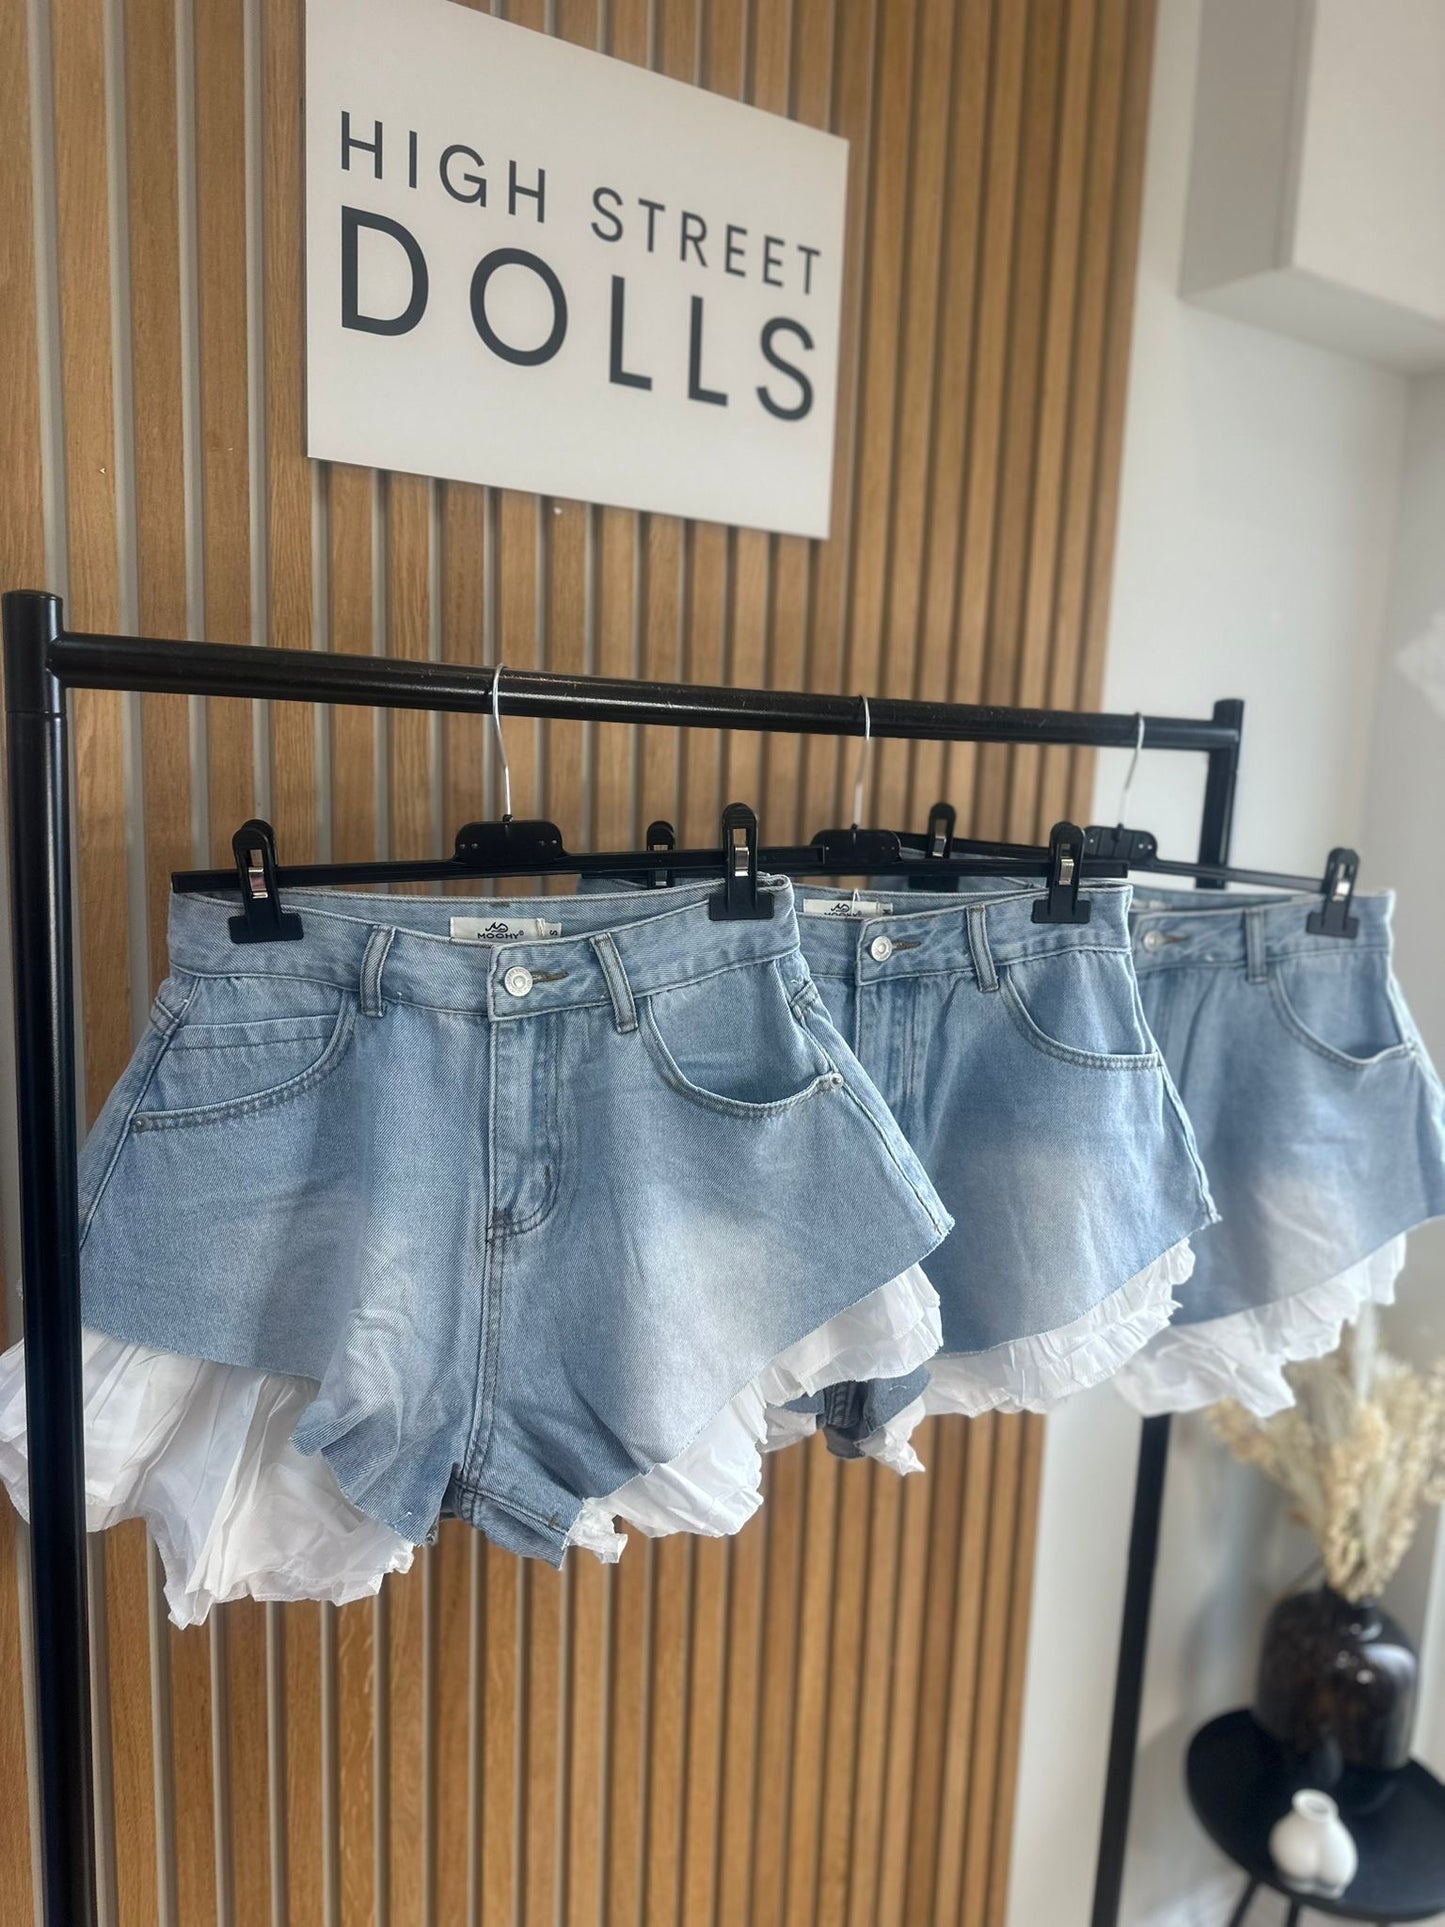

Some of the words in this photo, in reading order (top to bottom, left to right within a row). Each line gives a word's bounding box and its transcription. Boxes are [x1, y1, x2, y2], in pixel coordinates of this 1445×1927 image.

[341, 110, 546, 224] HIGH
[591, 186, 821, 295] STREET
[341, 204, 816, 422] DOLLS
